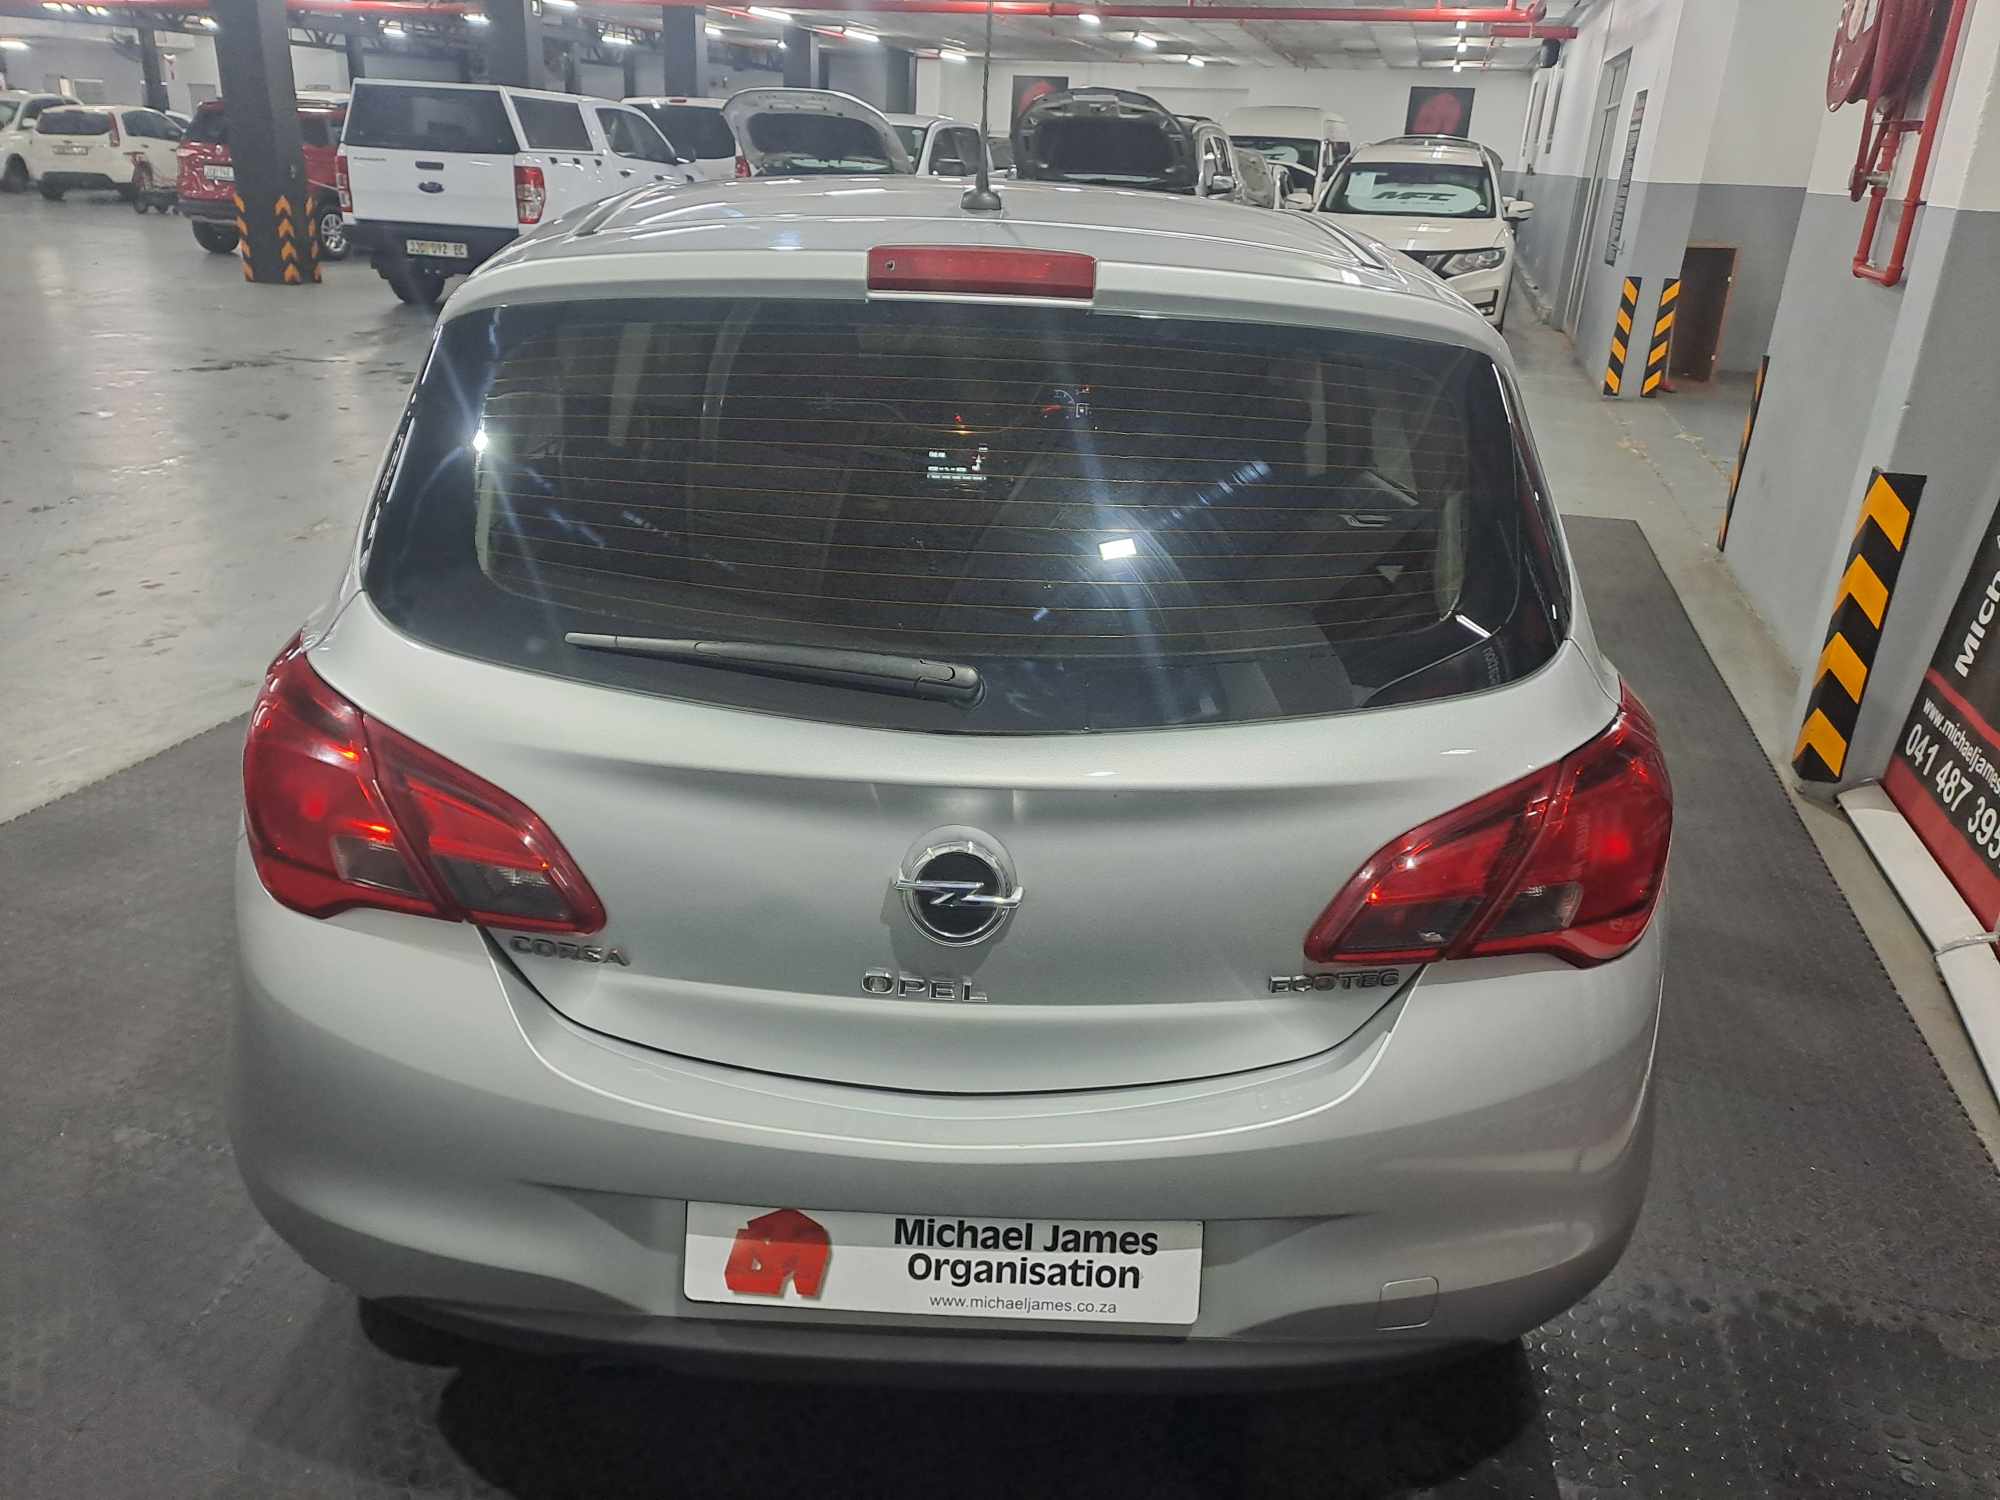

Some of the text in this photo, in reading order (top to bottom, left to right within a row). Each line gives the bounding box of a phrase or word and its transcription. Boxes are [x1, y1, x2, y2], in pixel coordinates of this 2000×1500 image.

[1371, 190, 1457, 202] MFC
[1904, 723, 1940, 777] 041
[1935, 759, 1974, 812] 487
[509, 935, 631, 966] CORSA
[861, 967, 989, 1003] OPEL
[1268, 968, 1401, 993] ECOTEC
[893, 1217, 1159, 1256] Michael James
[907, 1252, 1141, 1289] Organisation
[928, 1295, 1118, 1315] www.michaeljames.co.za
